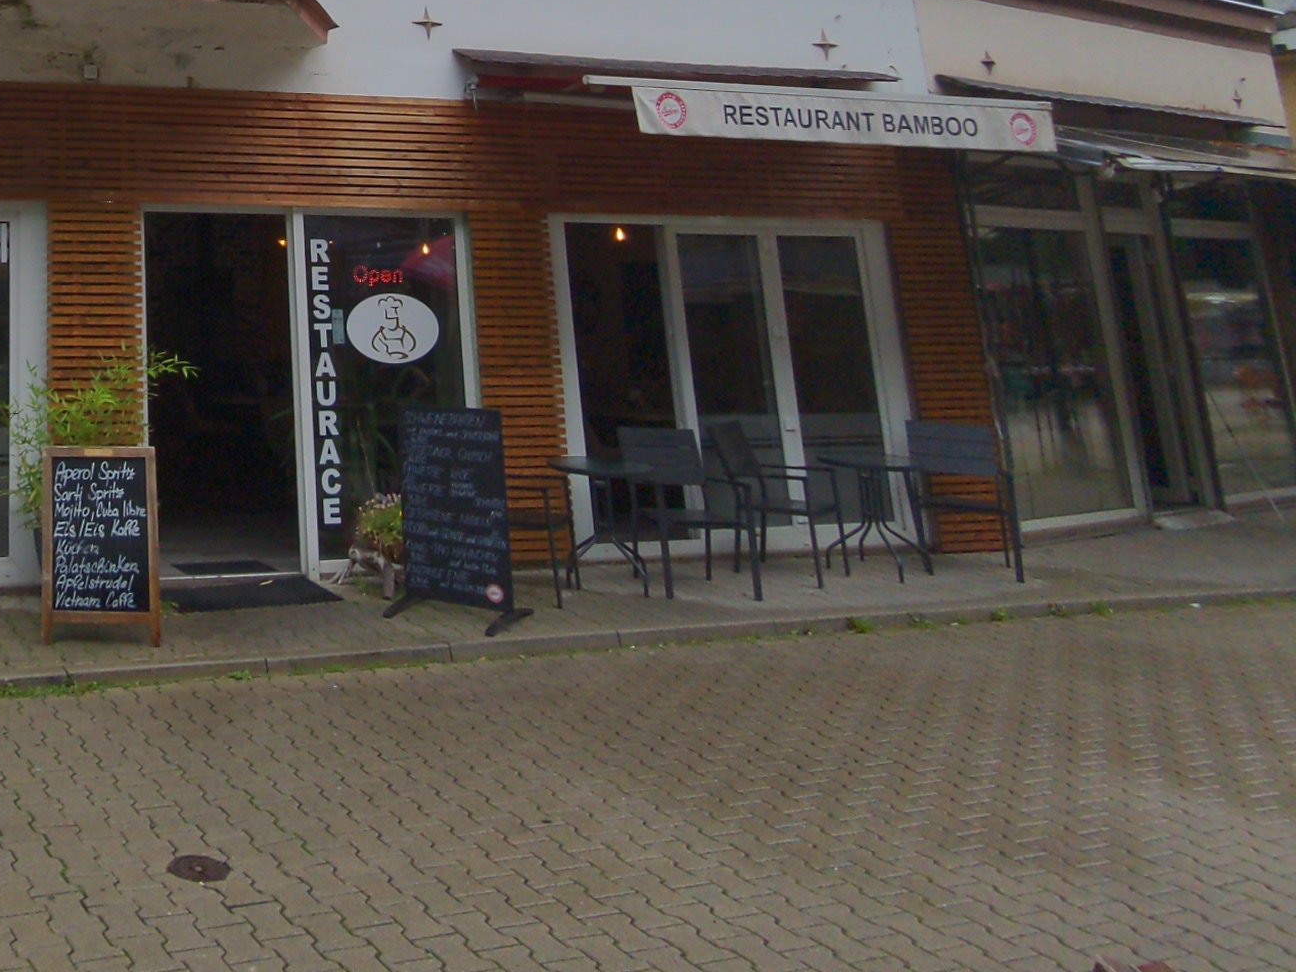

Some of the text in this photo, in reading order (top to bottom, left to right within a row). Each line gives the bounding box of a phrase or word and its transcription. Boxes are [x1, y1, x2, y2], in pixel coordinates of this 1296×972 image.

[722, 103, 875, 133] RESTAURANT
[882, 114, 979, 138] BAMBOO
[352, 264, 404, 286] Open
[310, 238, 342, 525] RESTAURACE
[55, 460, 95, 487] Aperol
[96, 501, 119, 518] Cuba
[123, 500, 147, 518] libre
[55, 573, 135, 593] Apfelstrudel
[55, 590, 101, 608] Vietnam
